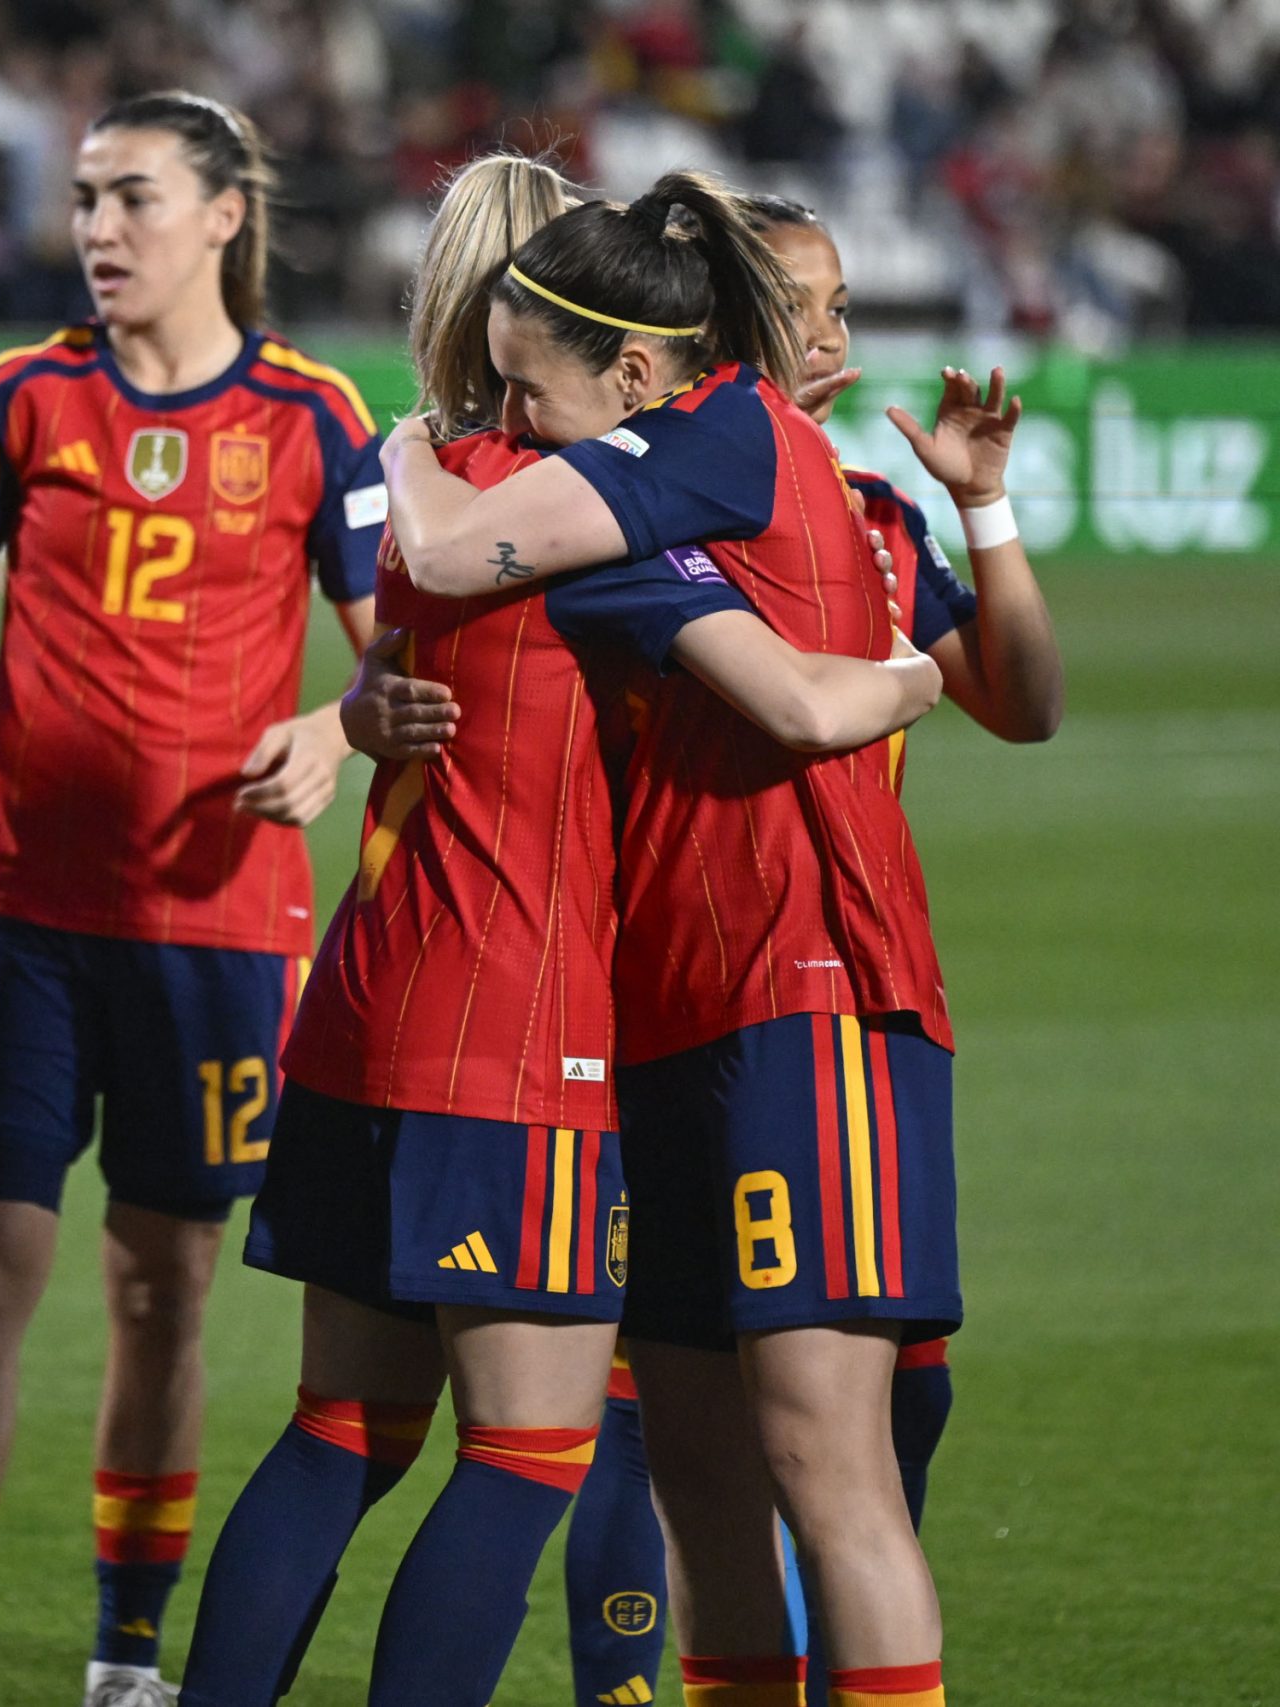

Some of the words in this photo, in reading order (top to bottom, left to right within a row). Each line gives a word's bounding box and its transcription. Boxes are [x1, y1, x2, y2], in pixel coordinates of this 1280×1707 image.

[102, 508, 195, 624] 12
[199, 1057, 271, 1165] 12
[733, 1170, 797, 1290] 8
